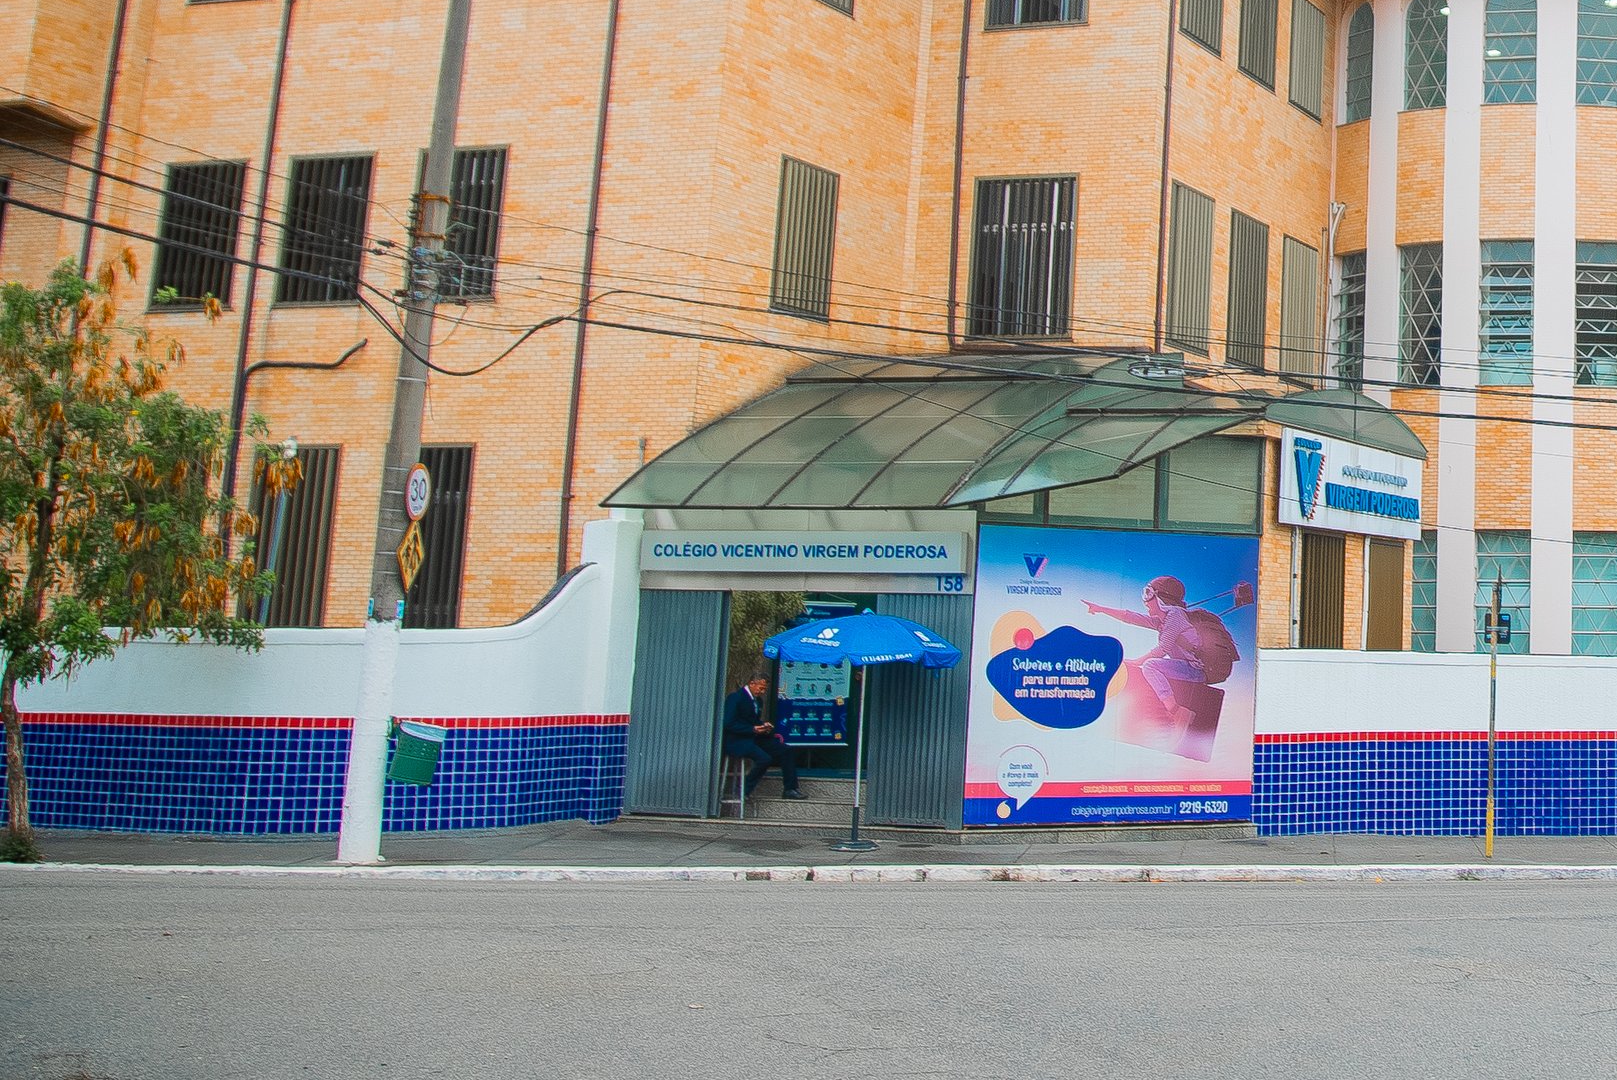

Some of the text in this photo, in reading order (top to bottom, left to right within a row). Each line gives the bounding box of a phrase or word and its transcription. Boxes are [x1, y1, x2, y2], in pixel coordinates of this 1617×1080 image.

[410, 478, 427, 502] 30
[1326, 482, 1420, 520] VIRGEM PODEROSA
[653, 541, 948, 559] COLÉGIO VICENTINO VIRGEM PODEROSA
[936, 575, 964, 592] 158
[1012, 658, 1106, 673] Saberes e Atitudes
[1022, 674, 1089, 686] para um mundo
[1014, 688, 1096, 700] em transformação
[1179, 801, 1228, 814] 2219-6320
